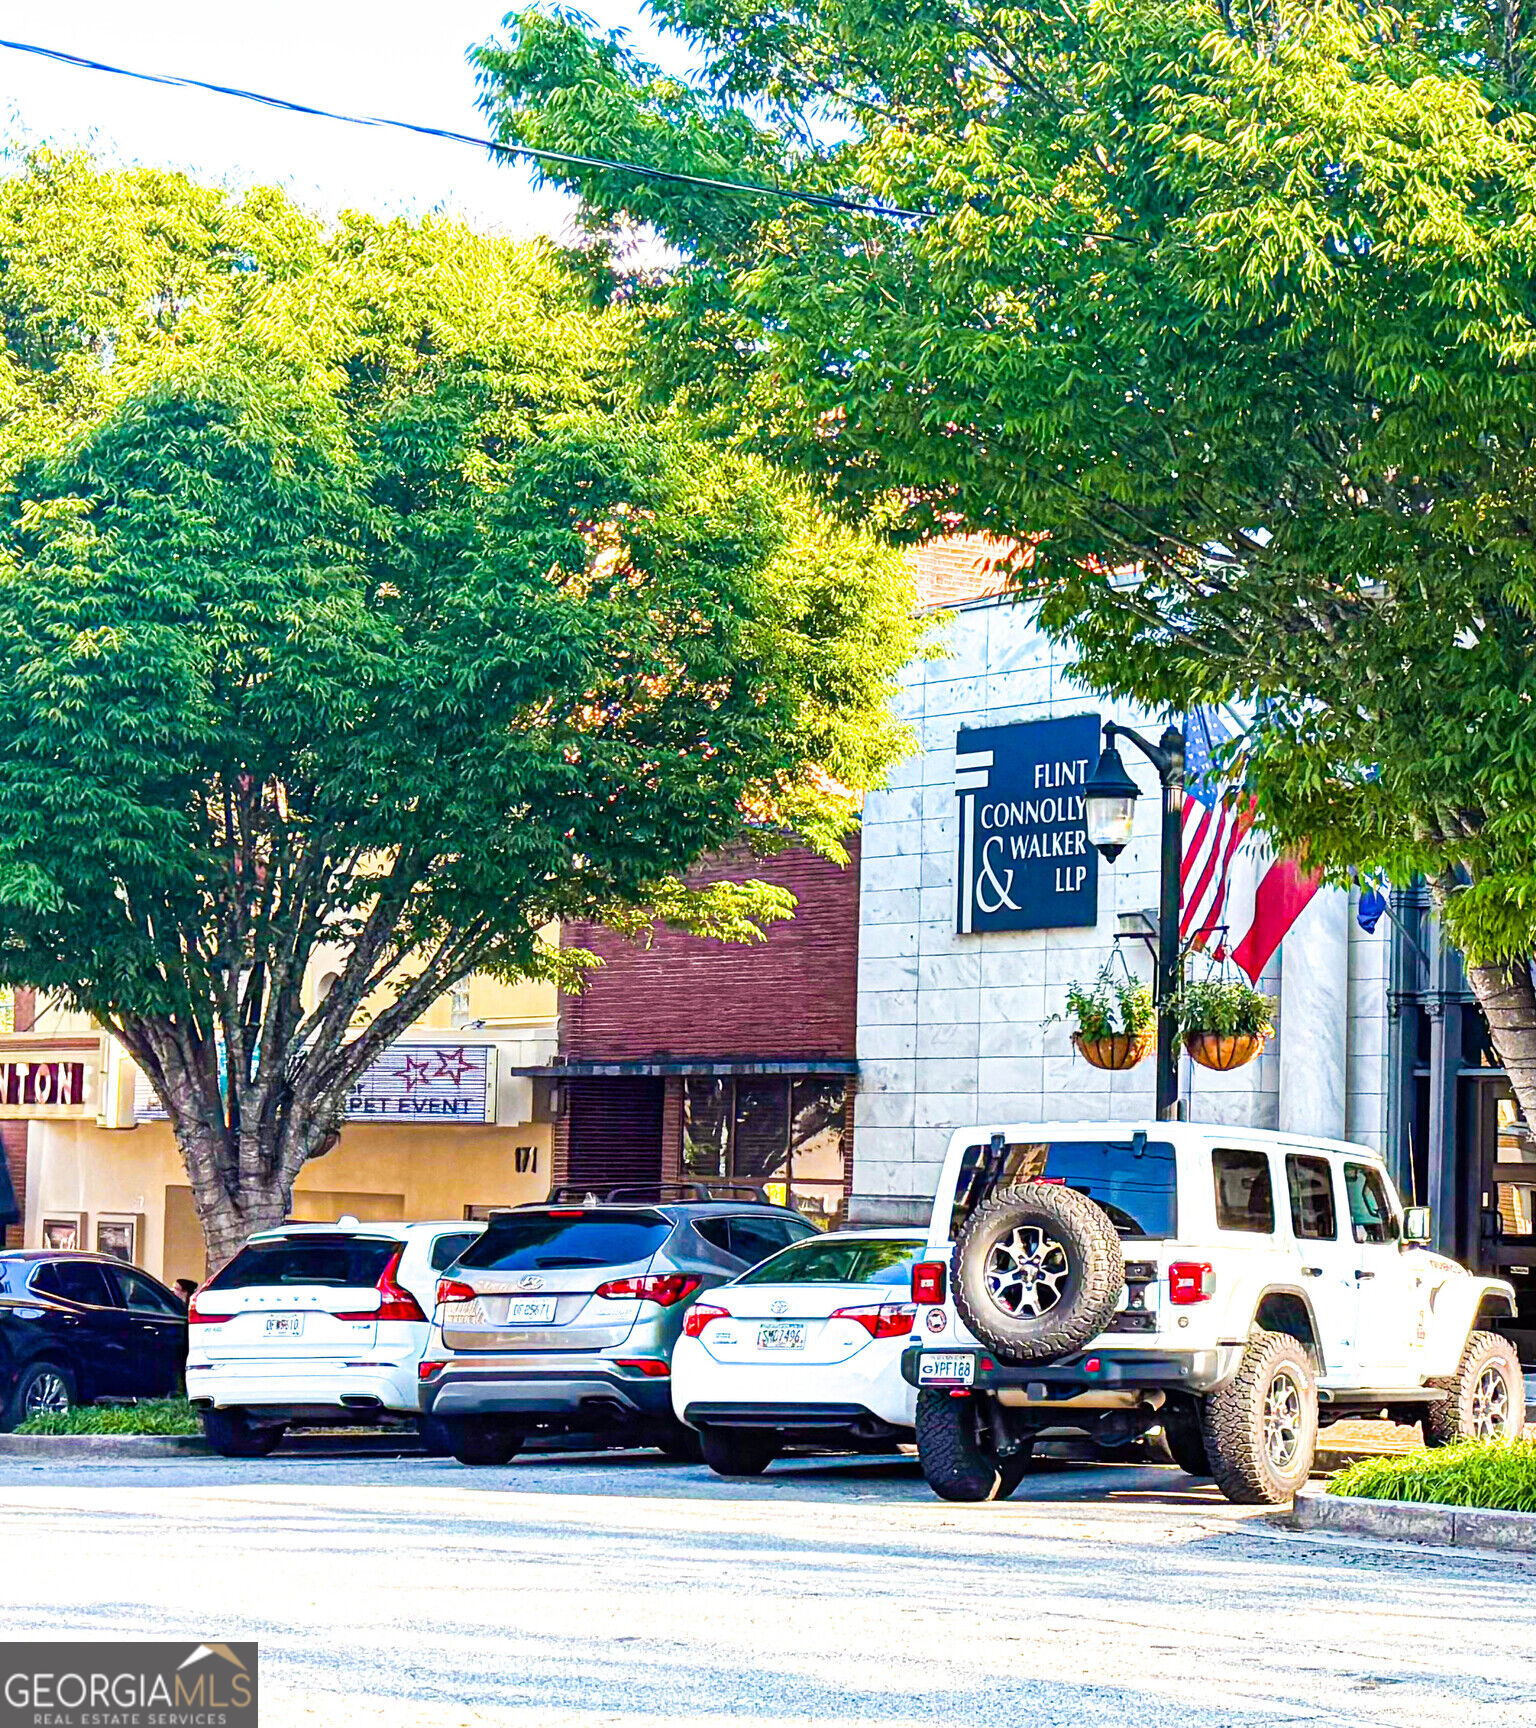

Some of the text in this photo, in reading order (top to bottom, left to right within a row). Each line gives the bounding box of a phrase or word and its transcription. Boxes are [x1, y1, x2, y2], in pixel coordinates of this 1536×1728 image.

[1034, 759, 1088, 789] FLINT
[981, 795, 1087, 829] CONNOLLY
[976, 830, 1087, 913] & WALKER
[1055, 866, 1087, 892] LLP
[345, 1097, 474, 1114] PET EVENT
[515, 1146, 537, 1174] 171
